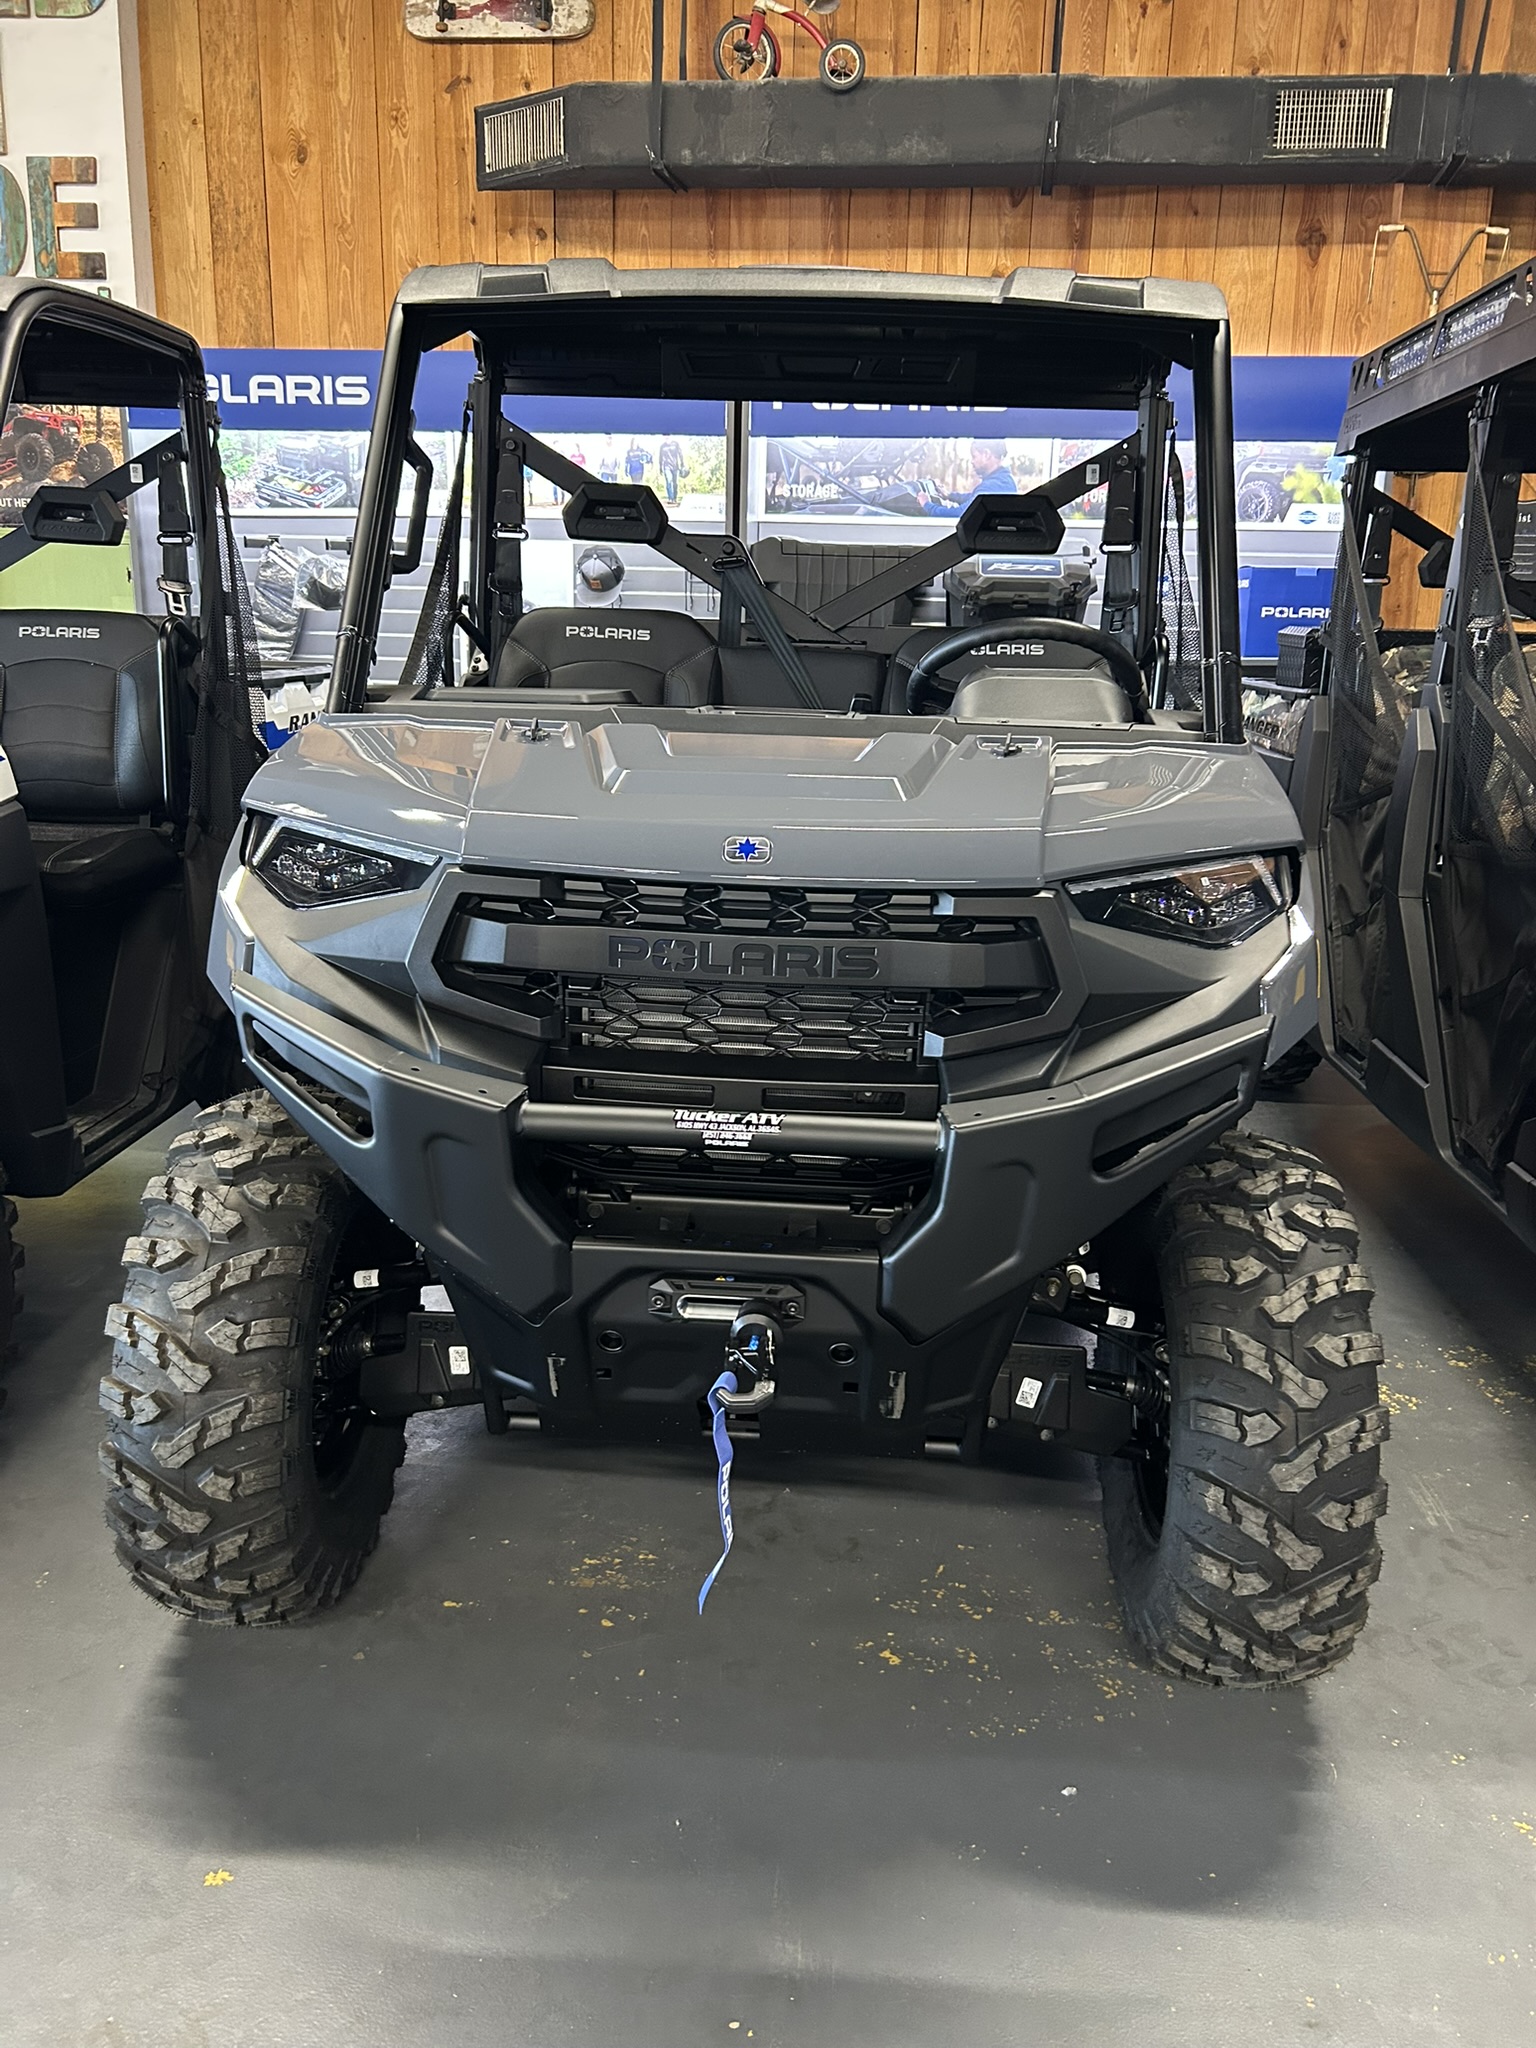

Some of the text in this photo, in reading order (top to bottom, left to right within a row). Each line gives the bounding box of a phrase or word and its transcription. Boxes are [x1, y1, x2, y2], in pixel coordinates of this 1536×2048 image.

[206, 373, 371, 406] LARIS
[783, 483, 839, 498] STORAGE
[1260, 606, 1333, 619] POLARI
[18, 625, 101, 639] POLARIS
[565, 625, 651, 641] POLARIS
[969, 643, 1045, 656] OLARIS
[1242, 715, 1280, 740] ANGER
[608, 934, 881, 980] POLARIS
[673, 1109, 787, 1125] Tucker ATV
